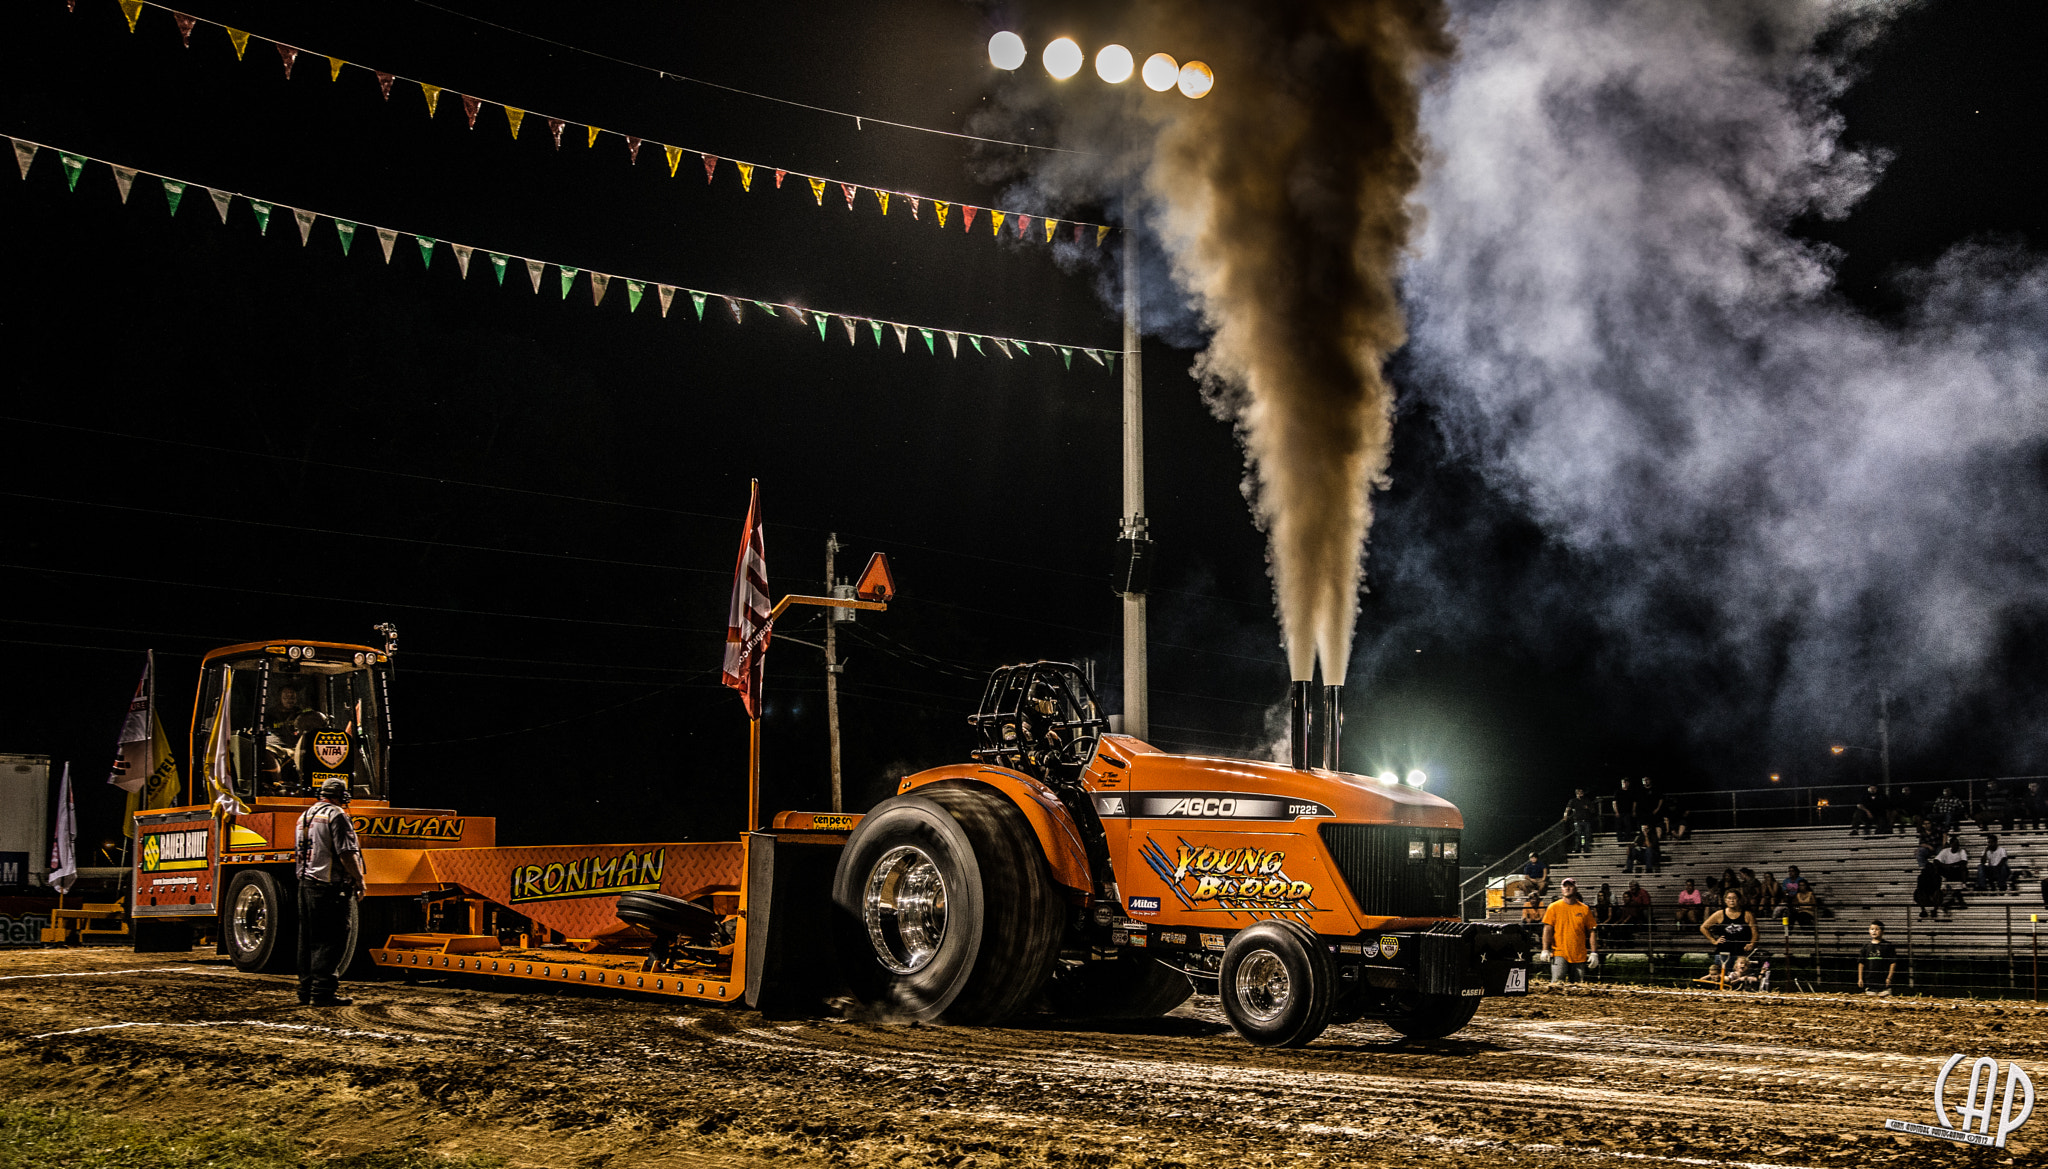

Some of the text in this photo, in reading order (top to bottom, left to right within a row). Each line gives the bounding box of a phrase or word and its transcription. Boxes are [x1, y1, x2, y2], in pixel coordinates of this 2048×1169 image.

[322, 745, 342, 756] NTPA
[1169, 798, 1317, 817] AGCO DT225
[352, 816, 465, 837] ONMAN
[160, 831, 208, 860] BAUER BUILT
[512, 848, 665, 897] IRONMAN
[1174, 845, 1285, 884] YOUNG
[1191, 876, 1314, 902] BLOOD
[1130, 898, 1158, 909] Mitas
[1511, 973, 1520, 987] 16
